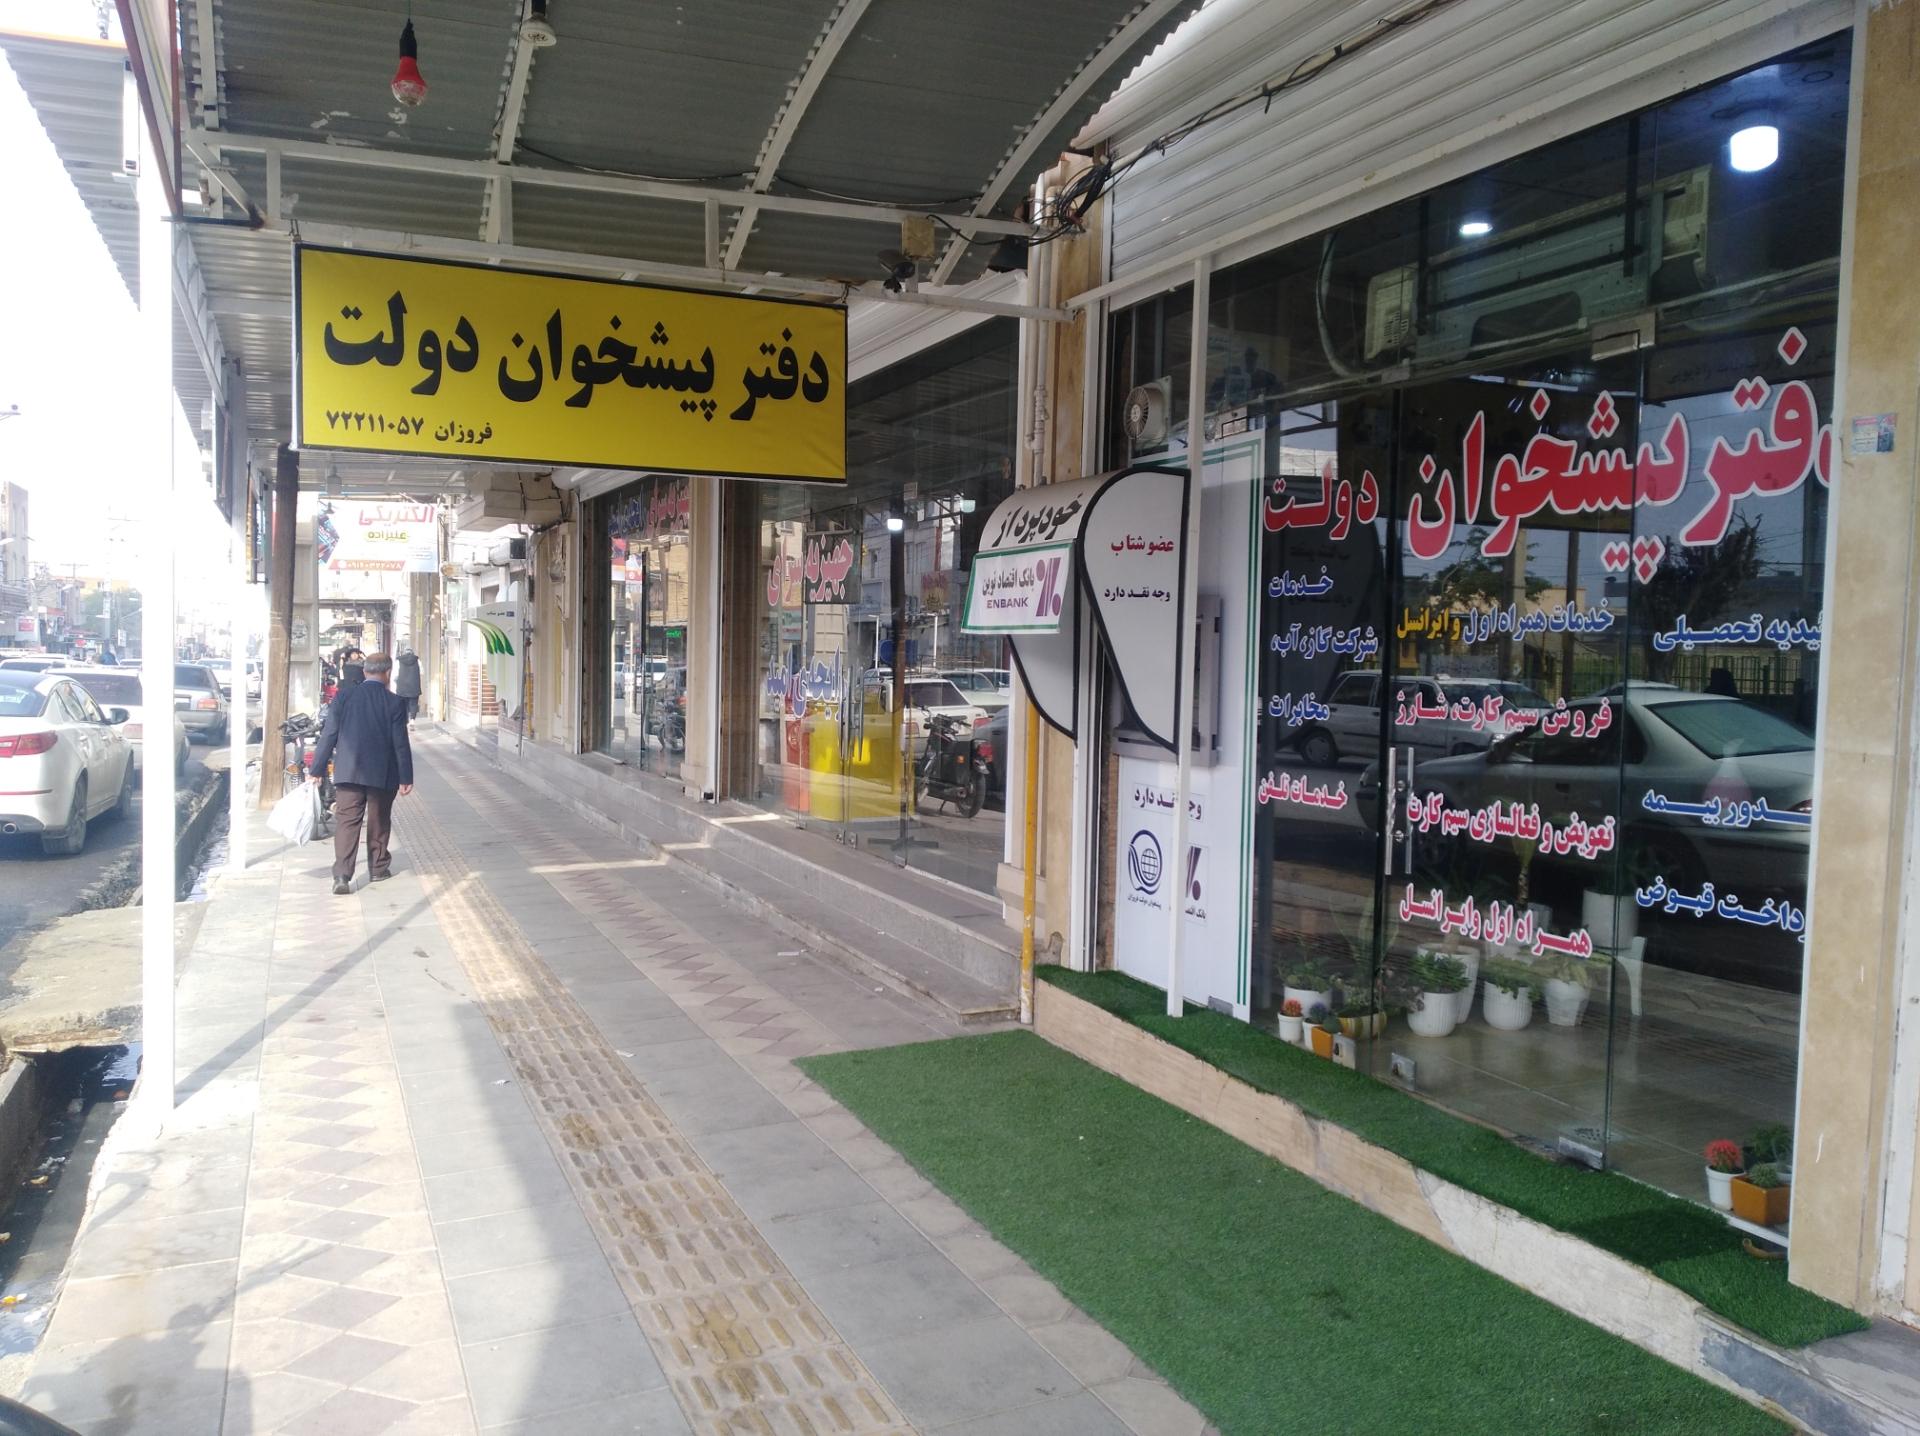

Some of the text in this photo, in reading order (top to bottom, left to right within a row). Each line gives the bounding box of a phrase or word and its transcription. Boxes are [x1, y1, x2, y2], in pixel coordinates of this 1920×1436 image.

[323, 290, 830, 422] دفتر پیشخوان دولت
[434, 420, 493, 444] فروزان
[1263, 326, 1832, 585] فتر پیشخوان دولت
[358, 505, 435, 526] الکتریکی
[992, 493, 1083, 547] خودپرداز
[1111, 533, 1175, 556] عضو شتاب
[982, 566, 1035, 596] بانک اقتصاد نوین
[1104, 587, 1170, 602] وجه نقد دارد
[1268, 565, 1334, 597] خدمات
[986, 597, 1029, 609] ENBANK
[1396, 597, 1615, 644] خدمات همراه اول و ایرانسل
[1331, 626, 1379, 662] شرکت
[1653, 612, 1763, 651] تحصیلی
[1268, 692, 1331, 726] مخابرات
[1395, 690, 1448, 726] شارژ
[1503, 707, 1539, 733] سیم
[1542, 697, 1613, 737] فروش
[1134, 787, 1155, 808] دارد
[1188, 800, 1202, 820] وج
[1290, 774, 1348, 810] خدمات
[1642, 789, 1812, 827] دور بیمه
[1406, 791, 1616, 859] تعویض و فعالسازی سیم کارت
[1636, 875, 1715, 918] قبوض
[1483, 900, 1514, 945] اول
[1515, 910, 1593, 958] همراه
